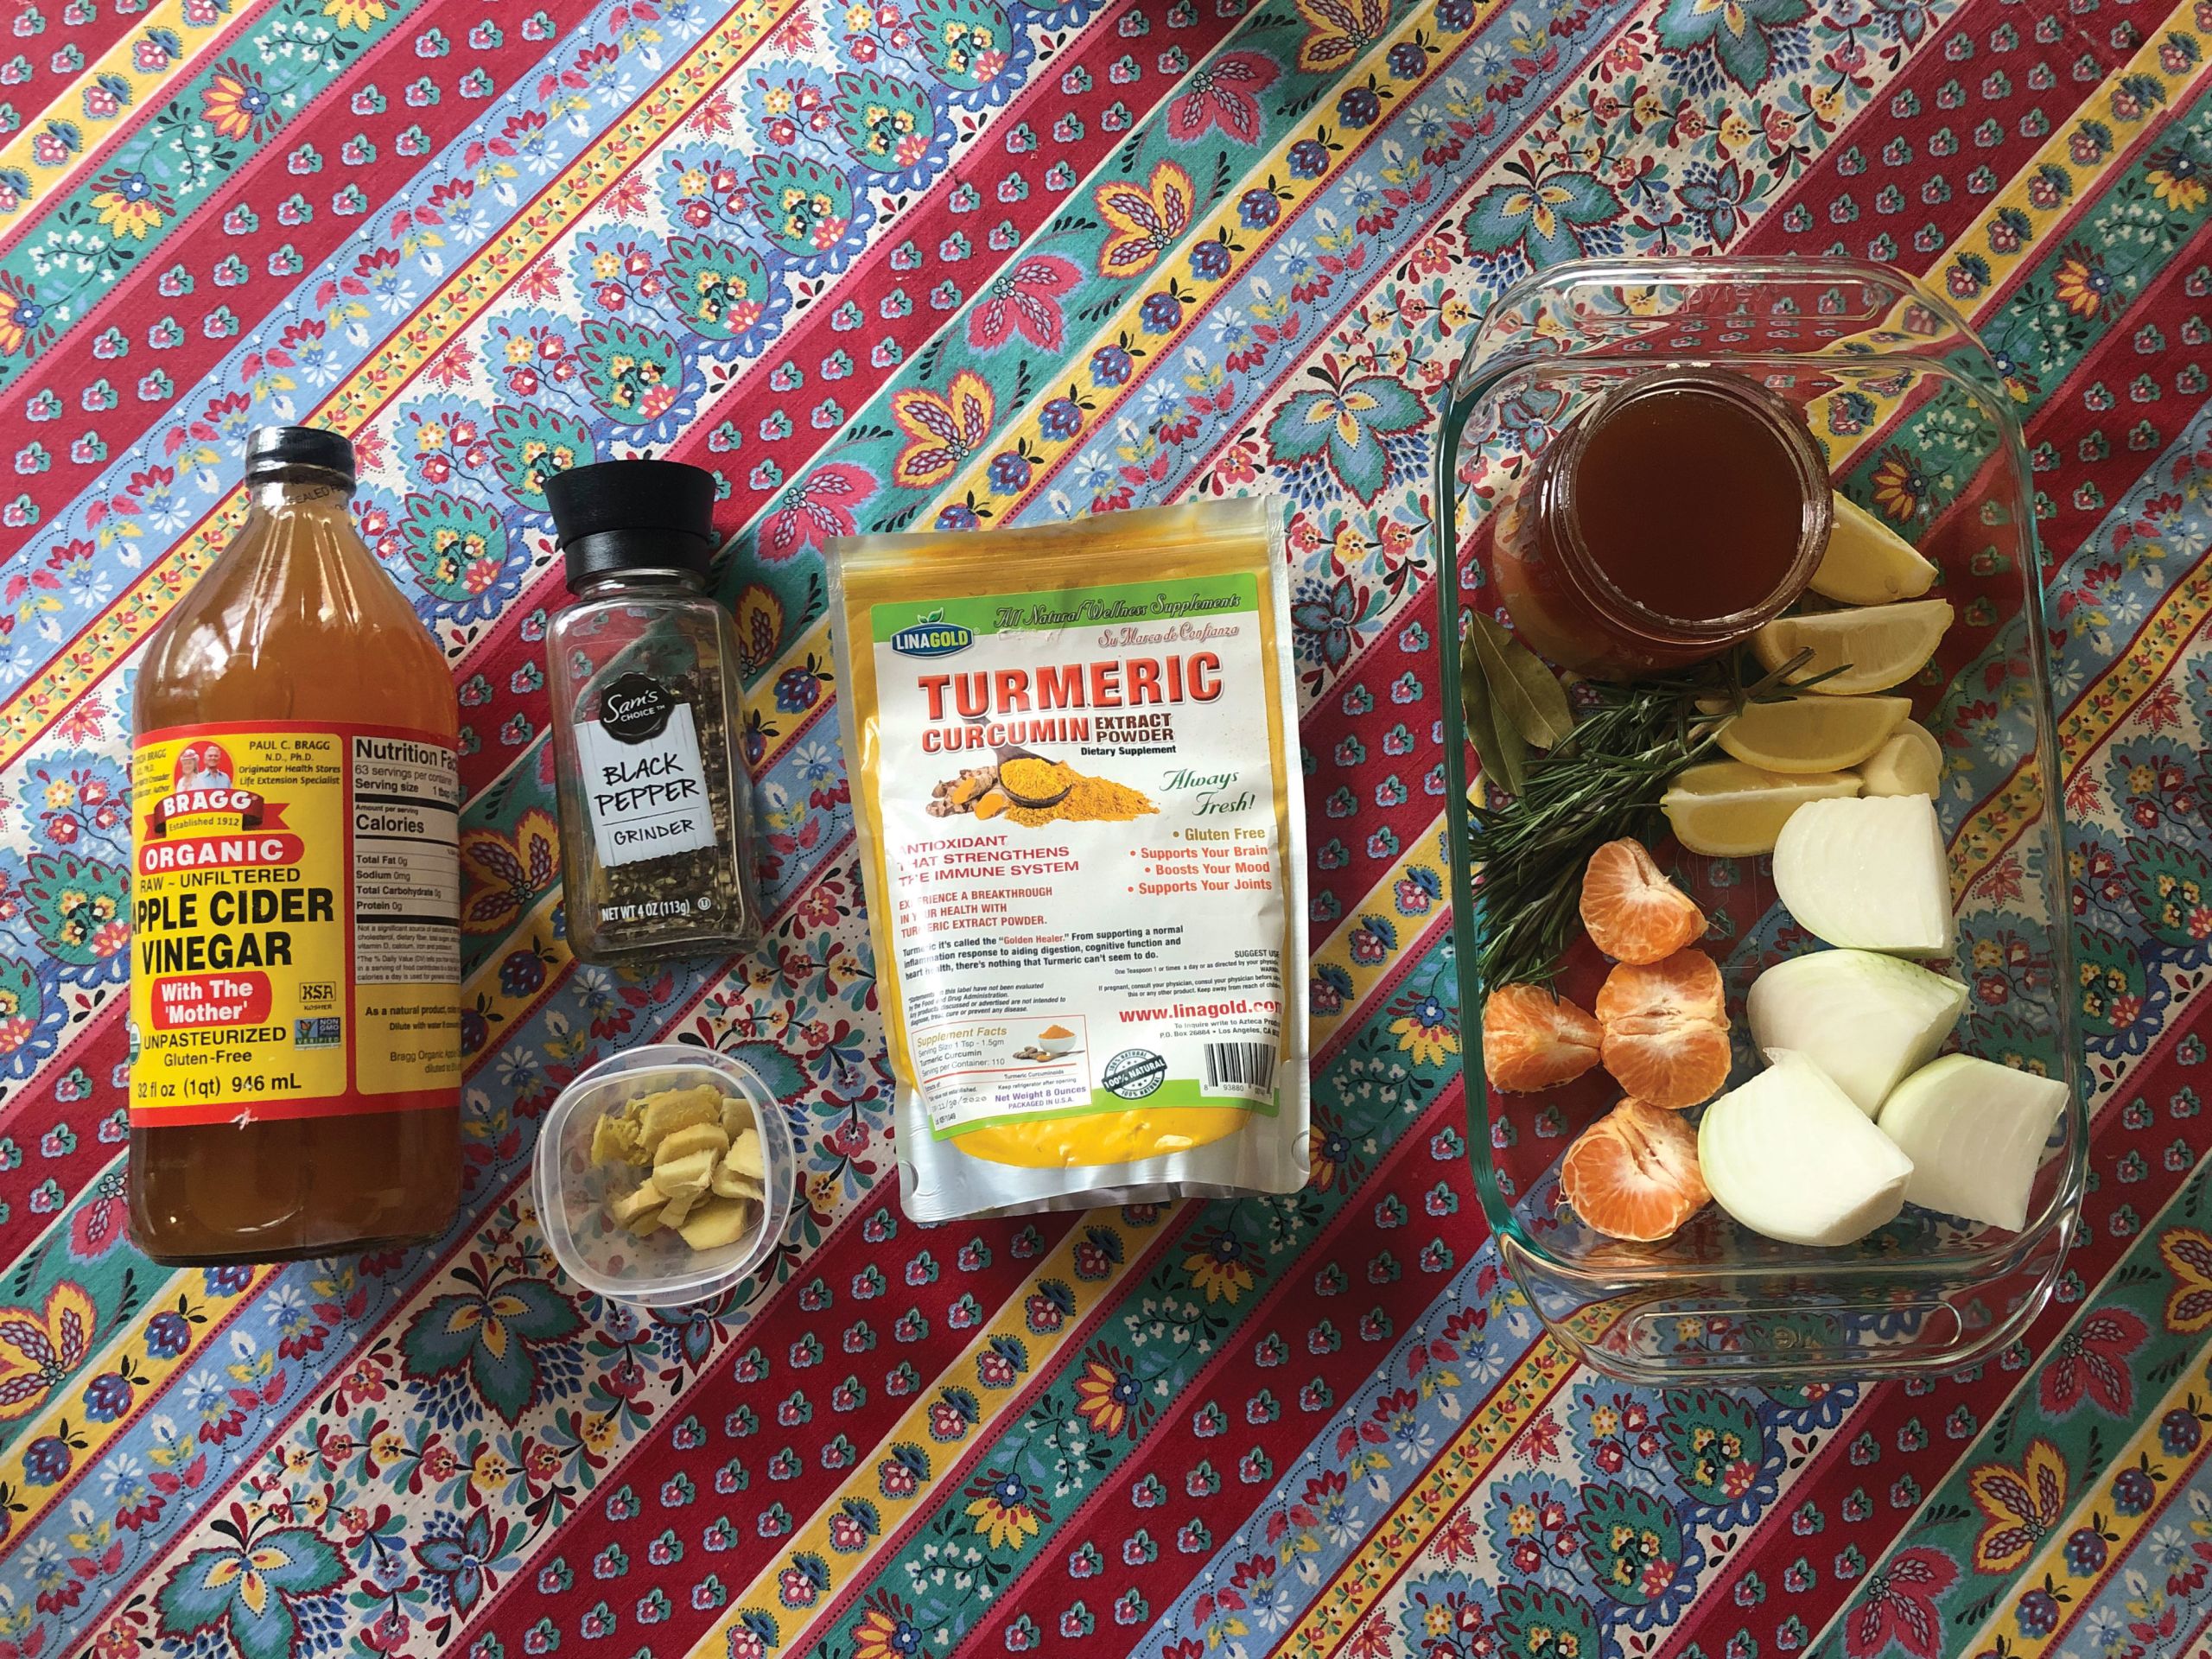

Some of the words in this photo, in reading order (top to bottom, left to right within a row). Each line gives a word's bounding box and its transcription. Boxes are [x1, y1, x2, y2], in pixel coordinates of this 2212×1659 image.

[994, 607, 1024, 627] All
[1023, 601, 1082, 625] Natural
[1083, 599, 1147, 620] Wellness
[1151, 594, 1241, 617] Supplements
[896, 632, 969, 650] LINAGOLD
[1098, 629, 1118, 647] Su
[1121, 626, 1161, 645] Marca
[1164, 628, 1177, 640] de
[1179, 622, 1239, 642] Confianza
[918, 652, 1223, 721] TURMERIC
[604, 690, 658, 724] Sam's
[620, 708, 655, 722] CHOICE
[1095, 713, 1171, 730] EXTRACT
[250, 741, 276, 750] PAUL
[281, 741, 290, 749] C.
[295, 741, 330, 750] BRAGG
[922, 717, 1089, 753] CURCUMIN
[1096, 728, 1174, 742] POWDER
[357, 739, 437, 766] Nutrition
[1081, 747, 1116, 757] Dietary
[1118, 745, 1176, 756] Supplement
[355, 765, 368, 774] 63
[372, 767, 411, 780] servings
[415, 772, 427, 780] per
[603, 753, 684, 786] BLACK
[1160, 769, 1239, 791] Always
[240, 777, 254, 786] Life
[355, 779, 397, 792] Serving
[401, 782, 418, 792] size
[163, 790, 251, 817] BRAGG
[594, 779, 700, 817] PEPPER
[1192, 791, 1255, 816] Fresh!
[169, 817, 213, 831] Established
[356, 814, 424, 833] Calories
[614, 819, 695, 845] GRINDER
[1185, 829, 1230, 840] Gluten
[1235, 829, 1265, 838] Free
[146, 840, 283, 870] ORGANIC
[357, 855, 378, 864] Total
[398, 857, 408, 866] 0g
[944, 847, 1070, 864] STRENGTHENS
[1141, 848, 1198, 861] Supports
[1201, 848, 1229, 857] Your
[1234, 845, 1268, 856] Brain
[394, 872, 410, 881] 0mg
[935, 866, 1005, 880] IMMUNE
[1011, 861, 1079, 875] SYSTEM
[1156, 864, 1198, 874] Boosts
[1203, 864, 1230, 874] Your
[1236, 861, 1269, 872] Mood
[141, 877, 163, 893] RAW
[181, 868, 301, 887] UNFILTERED
[1139, 881, 1197, 895] Supports
[1201, 880, 1229, 890] Your
[1235, 879, 1272, 890] Joints
[356, 886, 379, 894] Total
[383, 887, 433, 897] Carbohydrate
[899, 892, 958, 910] EXRIENCE
[962, 892, 968, 900] A
[971, 887, 1052, 899] BREAKTHROUGH
[132, 893, 197, 936] APPLE
[210, 888, 334, 926] CIDER
[392, 902, 402, 912] 0g
[601, 907, 619, 921] NET
[620, 906, 636, 918] WT
[638, 904, 644, 917] 4
[645, 902, 658, 916] OZ
[660, 900, 690, 917] (113g)
[900, 916, 909, 925] IN
[912, 909, 937, 921] YUR
[940, 905, 978, 916] HEALTH
[982, 904, 1007, 913] WITH
[901, 921, 949, 938] TURERIC
[952, 918, 998, 929] EXTRACT
[1001, 916, 1047, 925] POWDER.
[903, 944, 937, 957] Turmeic
[1096, 928, 1142, 940] supporting
[1154, 925, 1183, 935] normal
[958, 948, 997, 958] response
[1012, 947, 1038, 956] aiding
[1041, 945, 1083, 955] digestion,
[1085, 940, 1124, 952] cognitive
[1128, 938, 1162, 949] function
[143, 931, 292, 976] VINEGAR
[925, 964, 953, 976] hlth,
[956, 961, 985, 969] there's
[988, 959, 1020, 968] nothing
[1044, 955, 1081, 965] Turmeric
[162, 982, 202, 1002] With
[209, 980, 253, 997] The
[302, 985, 333, 1000] KSA
[166, 1001, 247, 1023] 'Mother'
[1119, 1000, 1281, 1022] www.linagold.com
[144, 1027, 286, 1050] UNPASTEURIZED
[918, 1028, 973, 1047] Supplement
[977, 1027, 1007, 1036] Facts
[919, 1056, 942, 1067] Turmeric
[944, 1050, 982, 1059] Curcumin
[1104, 1073, 1128, 1089] 100%
[1128, 1059, 1165, 1079] NATURAL
[138, 1084, 147, 1097] 32
[151, 1082, 156, 1097] fl
[161, 1084, 175, 1096] oz
[184, 1077, 220, 1098] (1qt)
[232, 1076, 265, 1092] 946
[271, 1073, 302, 1090] mL
[1013, 1090, 1043, 1100] Weight
[1054, 1086, 1086, 1095] Ounces
